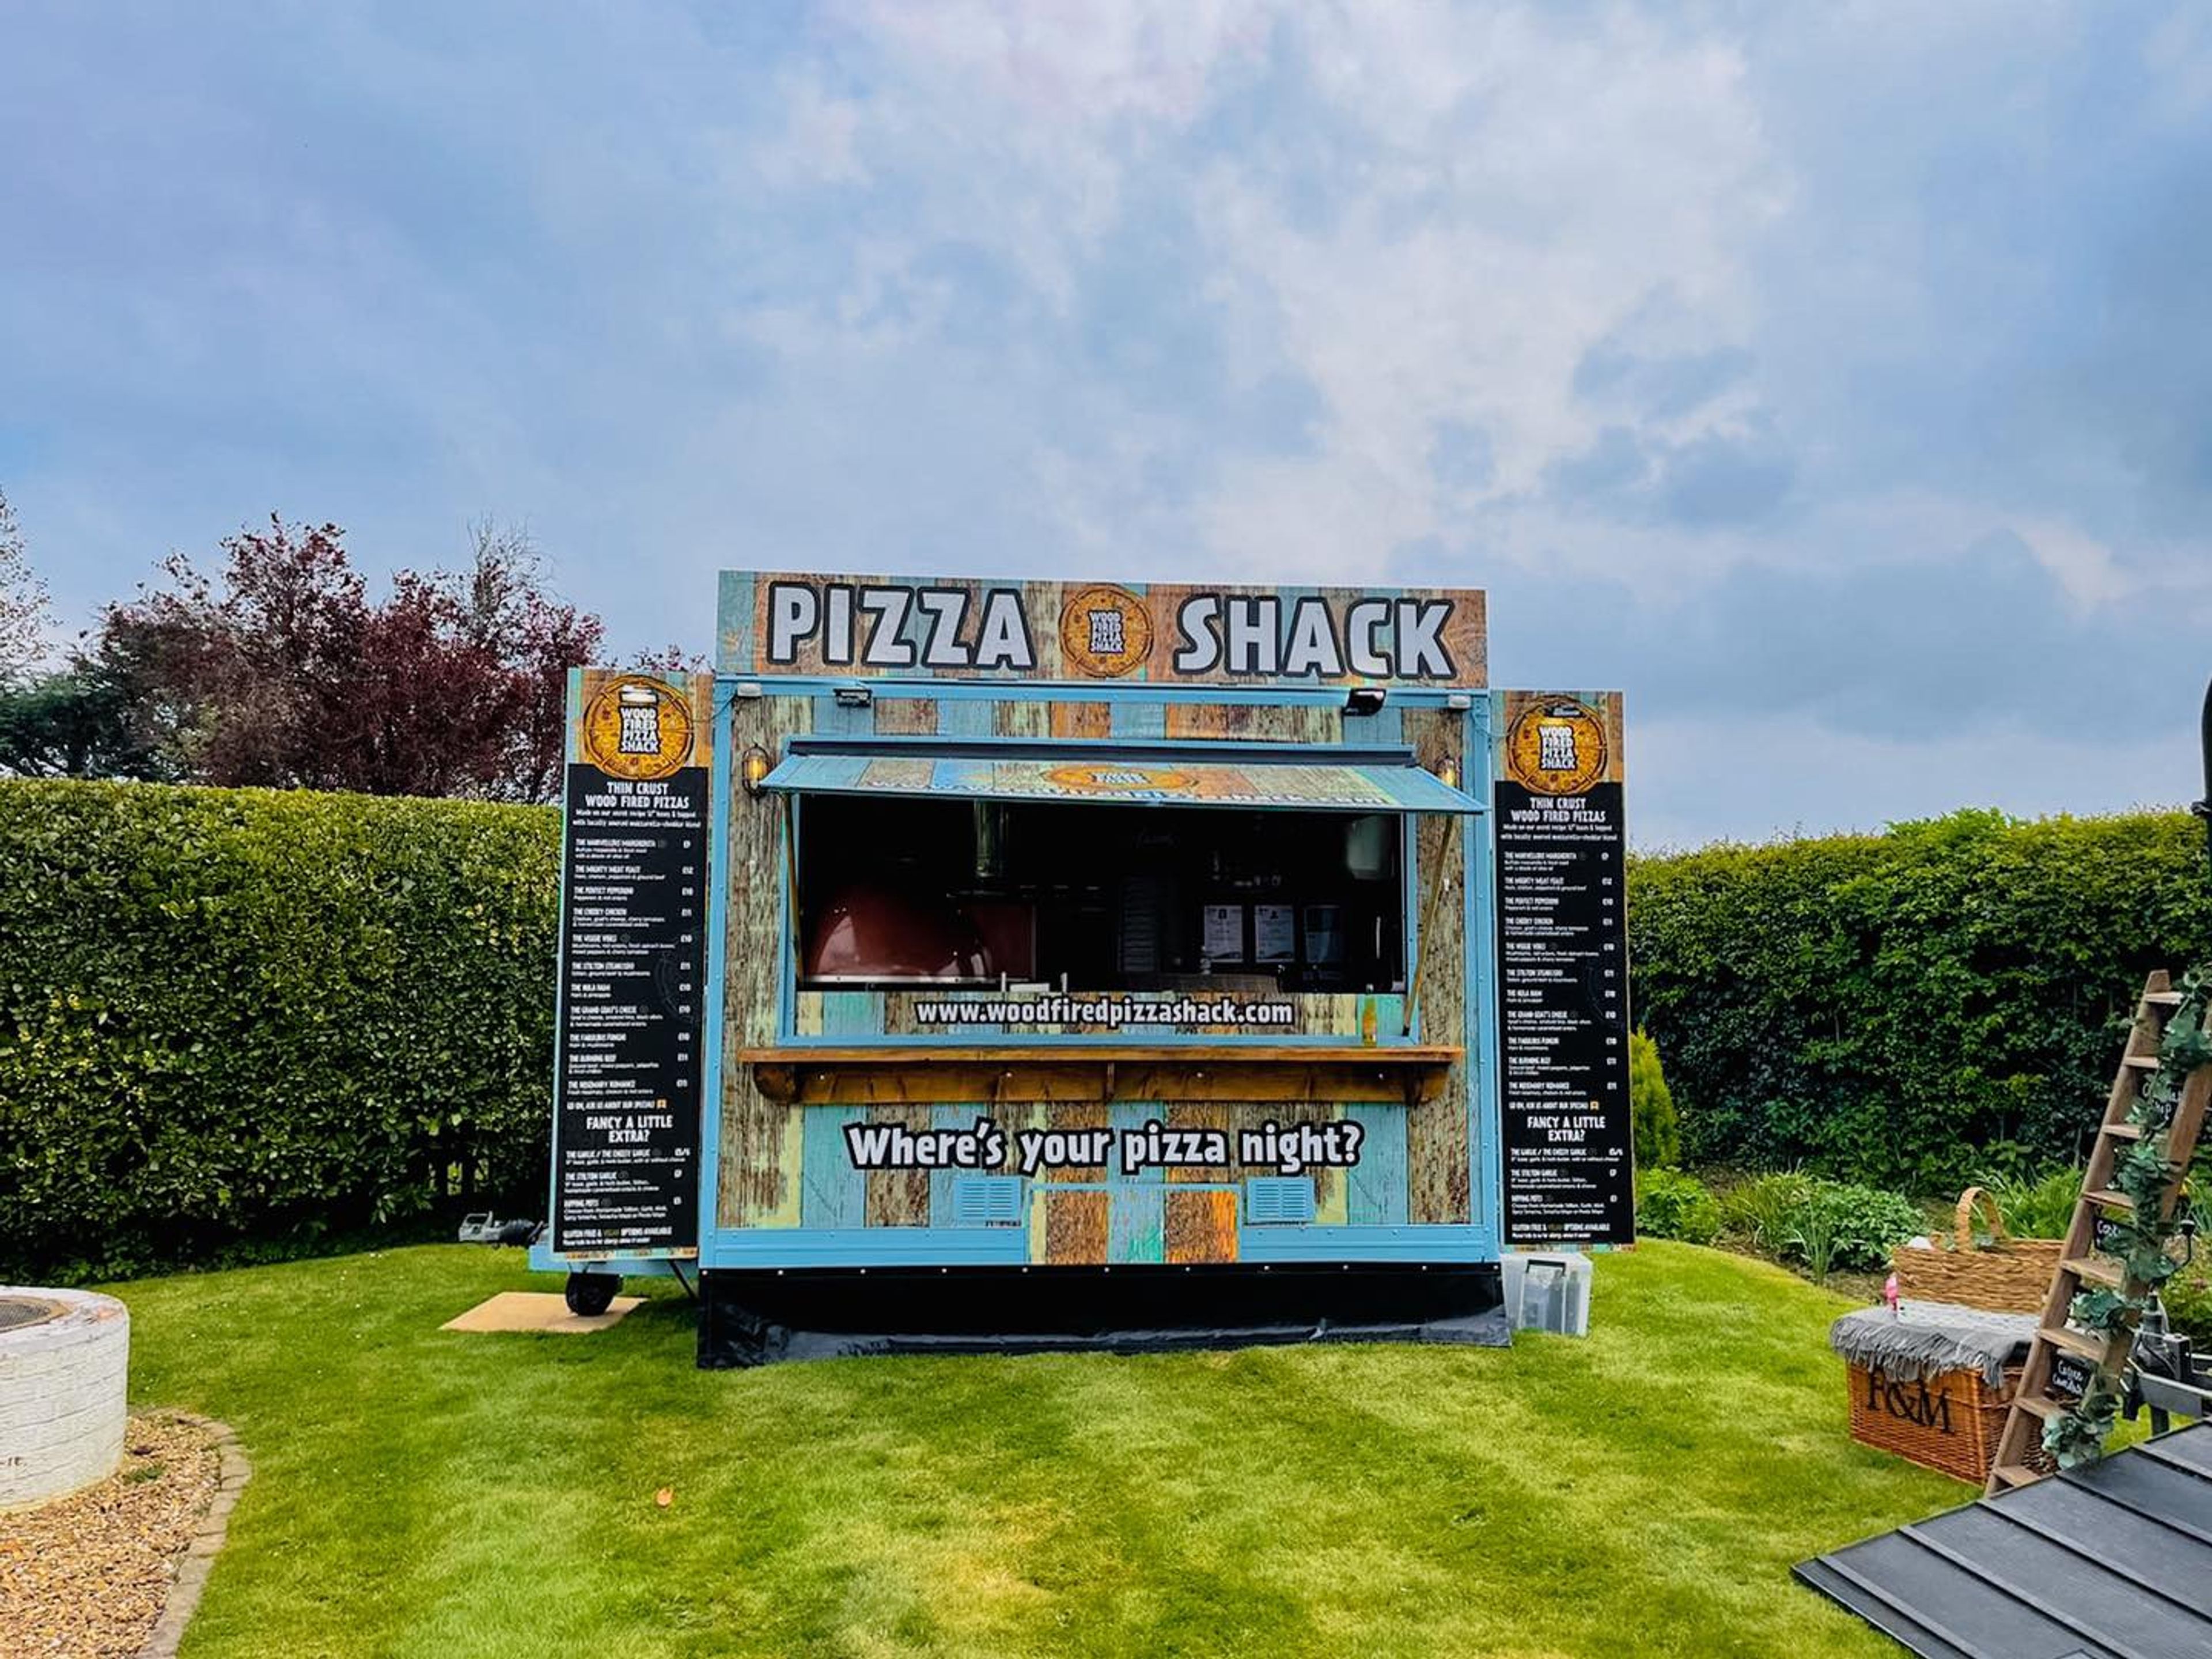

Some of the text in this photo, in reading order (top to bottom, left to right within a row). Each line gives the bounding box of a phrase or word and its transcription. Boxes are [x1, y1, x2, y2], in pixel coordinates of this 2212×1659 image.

[1089, 612, 1120, 622] WOOD
[772, 586, 1453, 676] PIZZA SHACK
[1092, 622, 1121, 632] FIRED
[1092, 632, 1122, 642] PIZZA
[1091, 641, 1123, 652] SHACK
[621, 708, 656, 718] WOOD
[624, 719, 656, 729] FIRED
[624, 730, 657, 741] PIZZA
[1539, 726, 1573, 736] WOOD
[621, 740, 658, 752] SHACK
[1543, 737, 1573, 747] FIRED
[1542, 748, 1574, 758] PIZZA
[1541, 758, 1575, 768] SHACK
[607, 782, 668, 794] THIN CRUST
[585, 795, 689, 808] WOOD FIRED PIZZAS
[1530, 797, 1586, 809] THIN CRUST
[1511, 810, 1606, 822] WOOD FIRED PIZZAS
[918, 998, 1293, 1027] www.woodfiredpizzashack.com
[587, 1115, 673, 1130] FANCY A LITTLE
[1528, 1116, 1606, 1128] FANCY A LITTLE
[608, 1130, 650, 1143] EXTRA?
[1548, 1130, 1585, 1142] EXTRA?
[849, 1122, 1362, 1173] Where's your pizza night?
